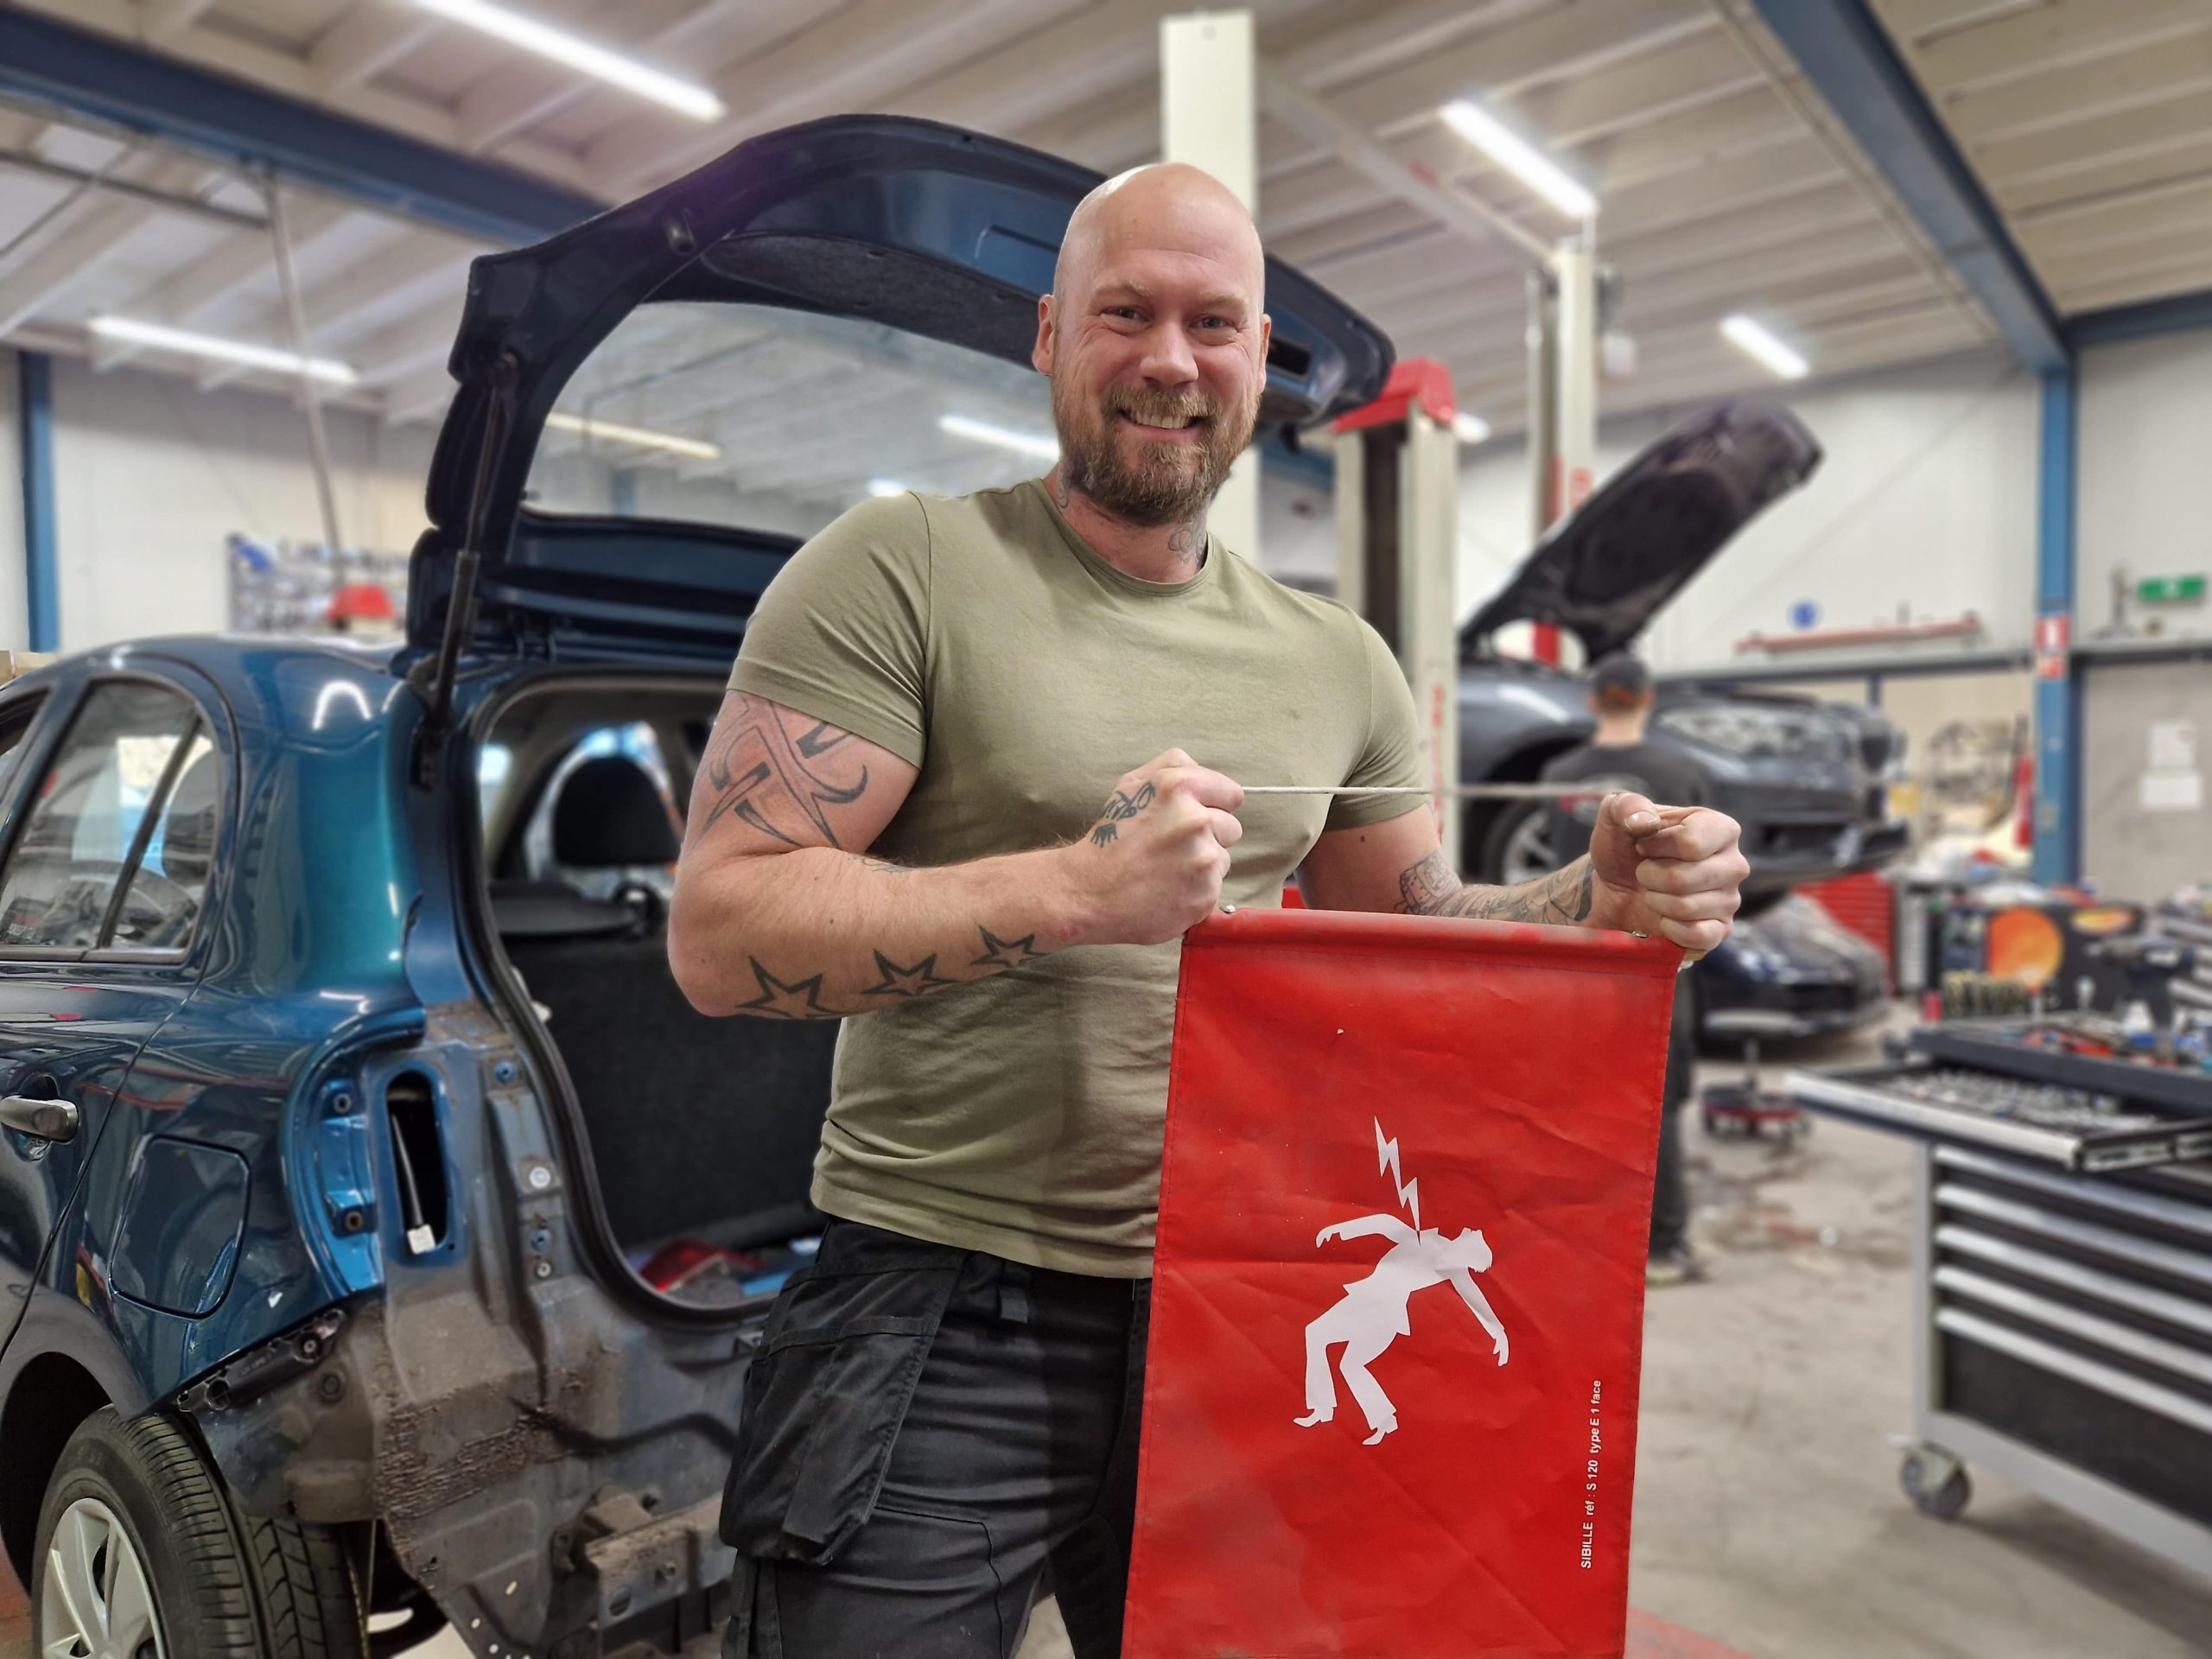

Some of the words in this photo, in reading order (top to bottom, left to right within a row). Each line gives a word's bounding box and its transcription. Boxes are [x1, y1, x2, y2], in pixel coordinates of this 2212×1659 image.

[1590, 1380, 1601, 1405] face
[1589, 1417, 1600, 1426] E
[1589, 1427, 1602, 1454] type
[1586, 1459, 1599, 1479] 120
[1586, 1483, 1597, 1491] S
[1584, 1500, 1595, 1516] réf
[1580, 1522, 1593, 1569] SIBILLE
